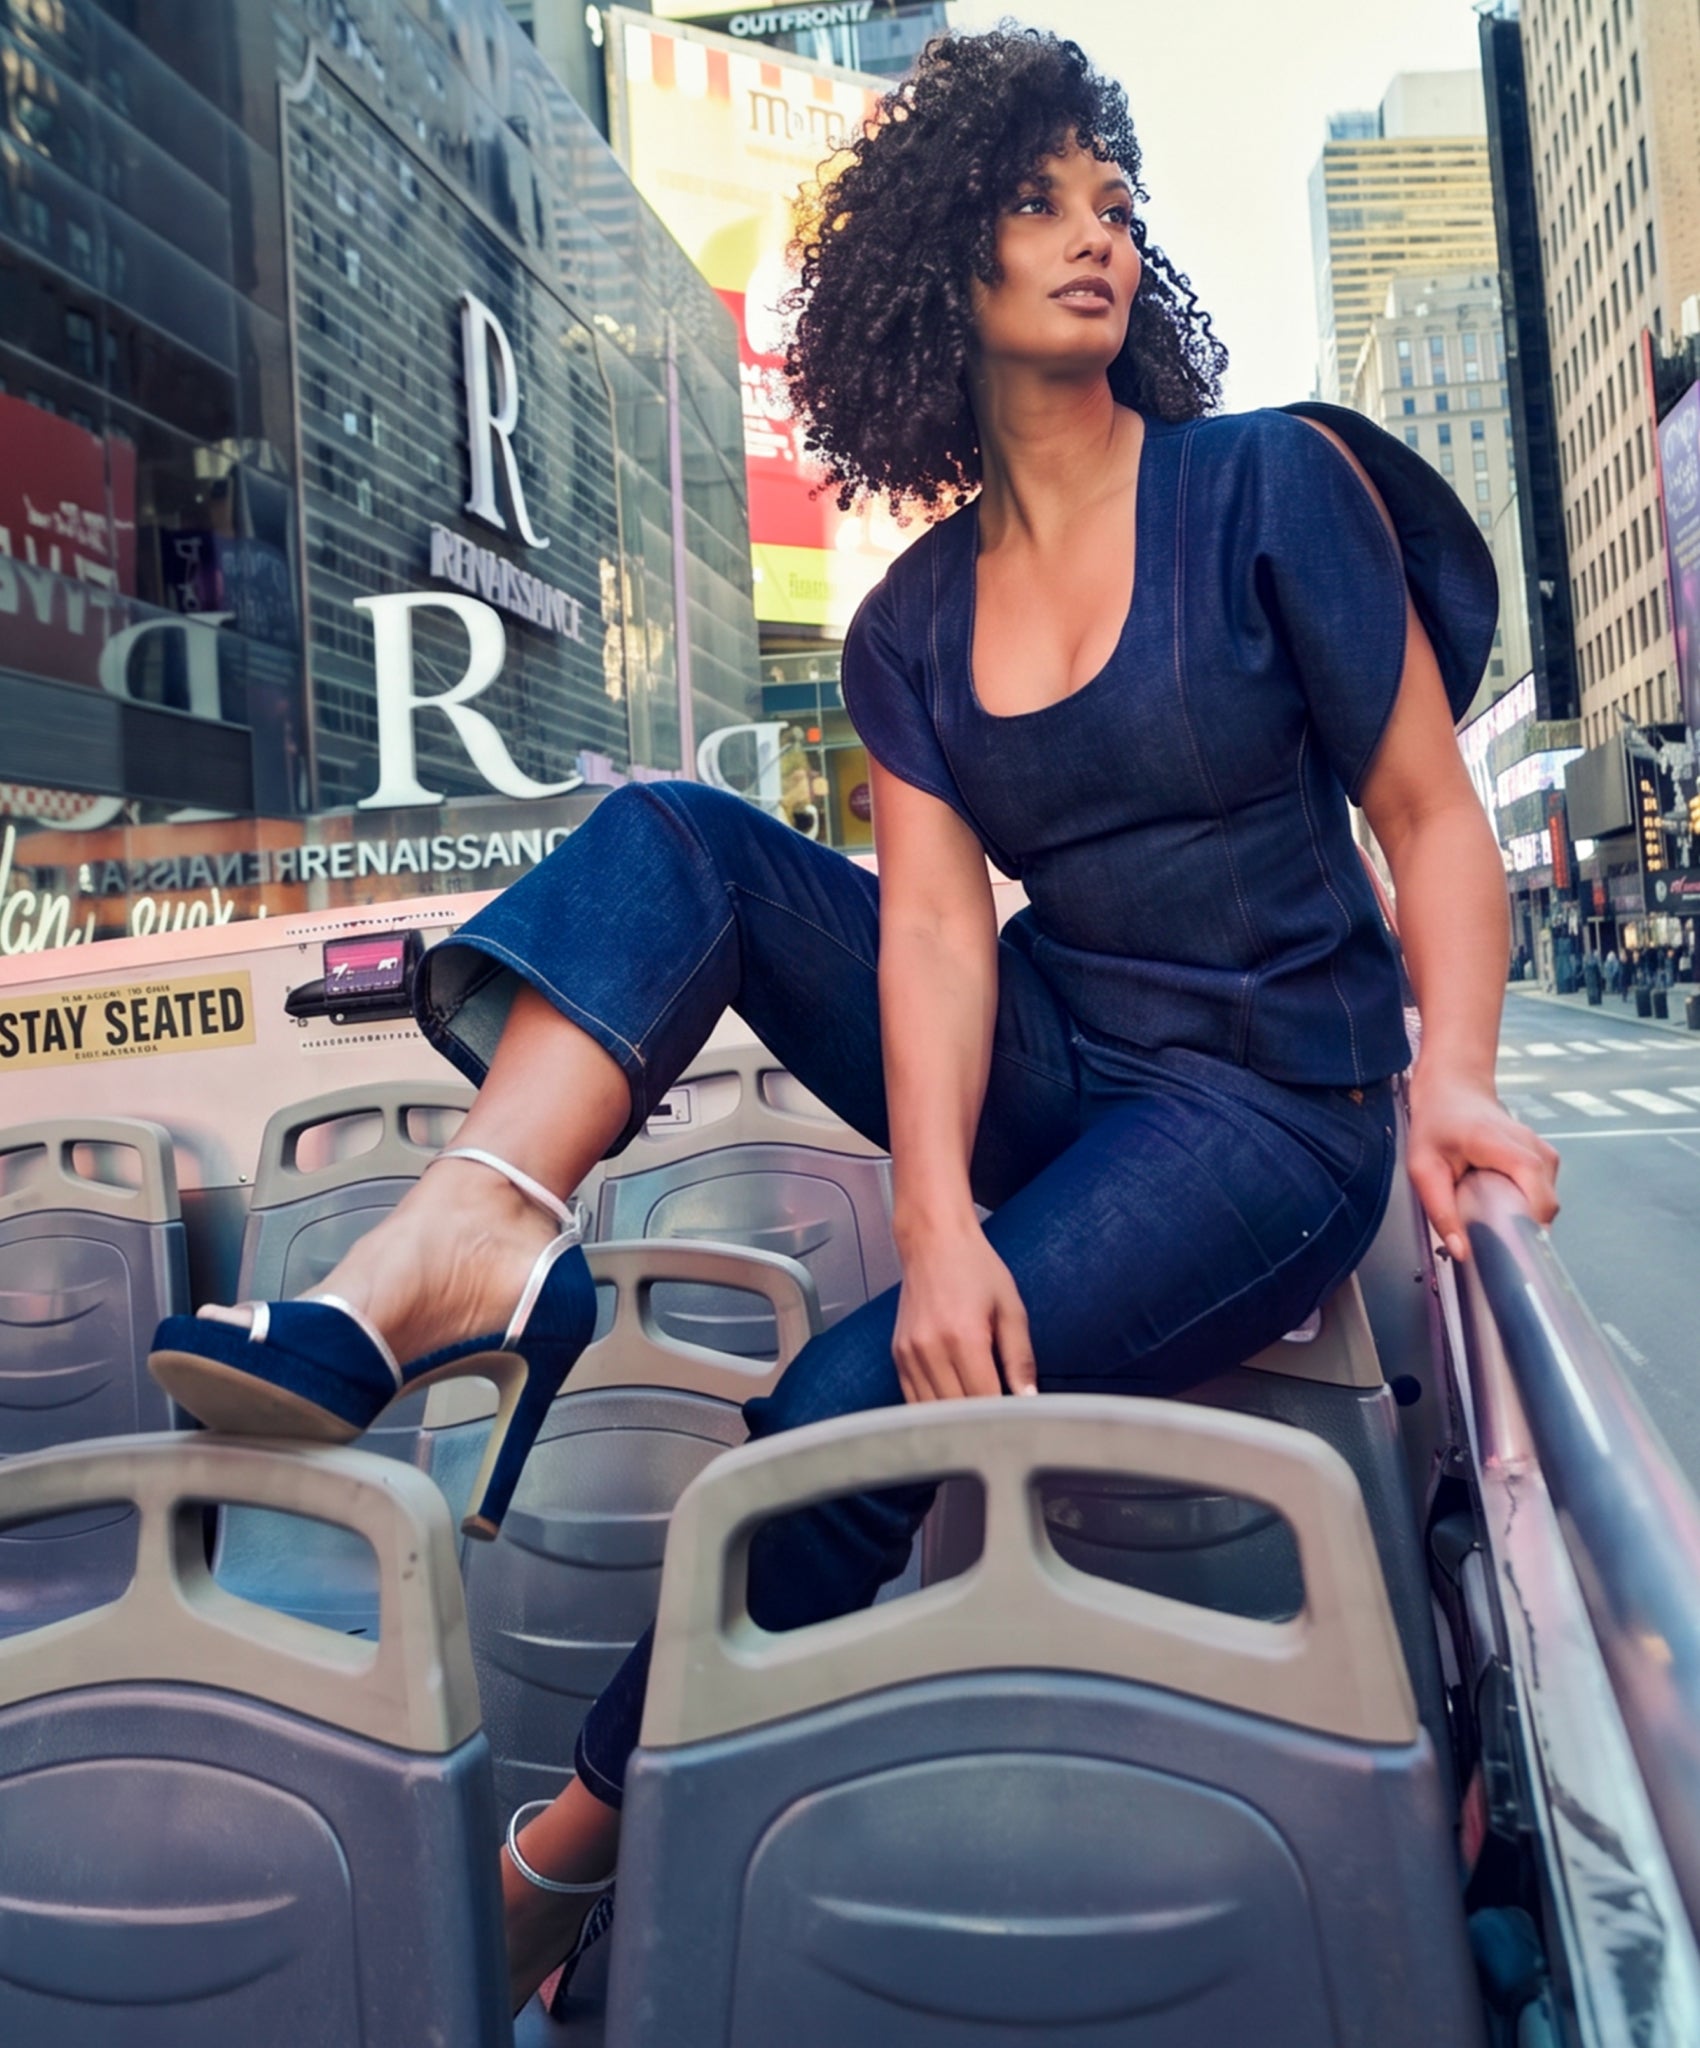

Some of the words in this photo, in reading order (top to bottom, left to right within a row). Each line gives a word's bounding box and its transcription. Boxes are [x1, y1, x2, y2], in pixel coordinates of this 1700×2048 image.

[461, 289, 550, 549] R
[430, 522, 585, 643] RENAISSANCE
[352, 591, 586, 810] R
[300, 826, 578, 881] RENAISSANC
[0, 1005, 87, 1058] STAY
[105, 987, 245, 1046] SEATED
